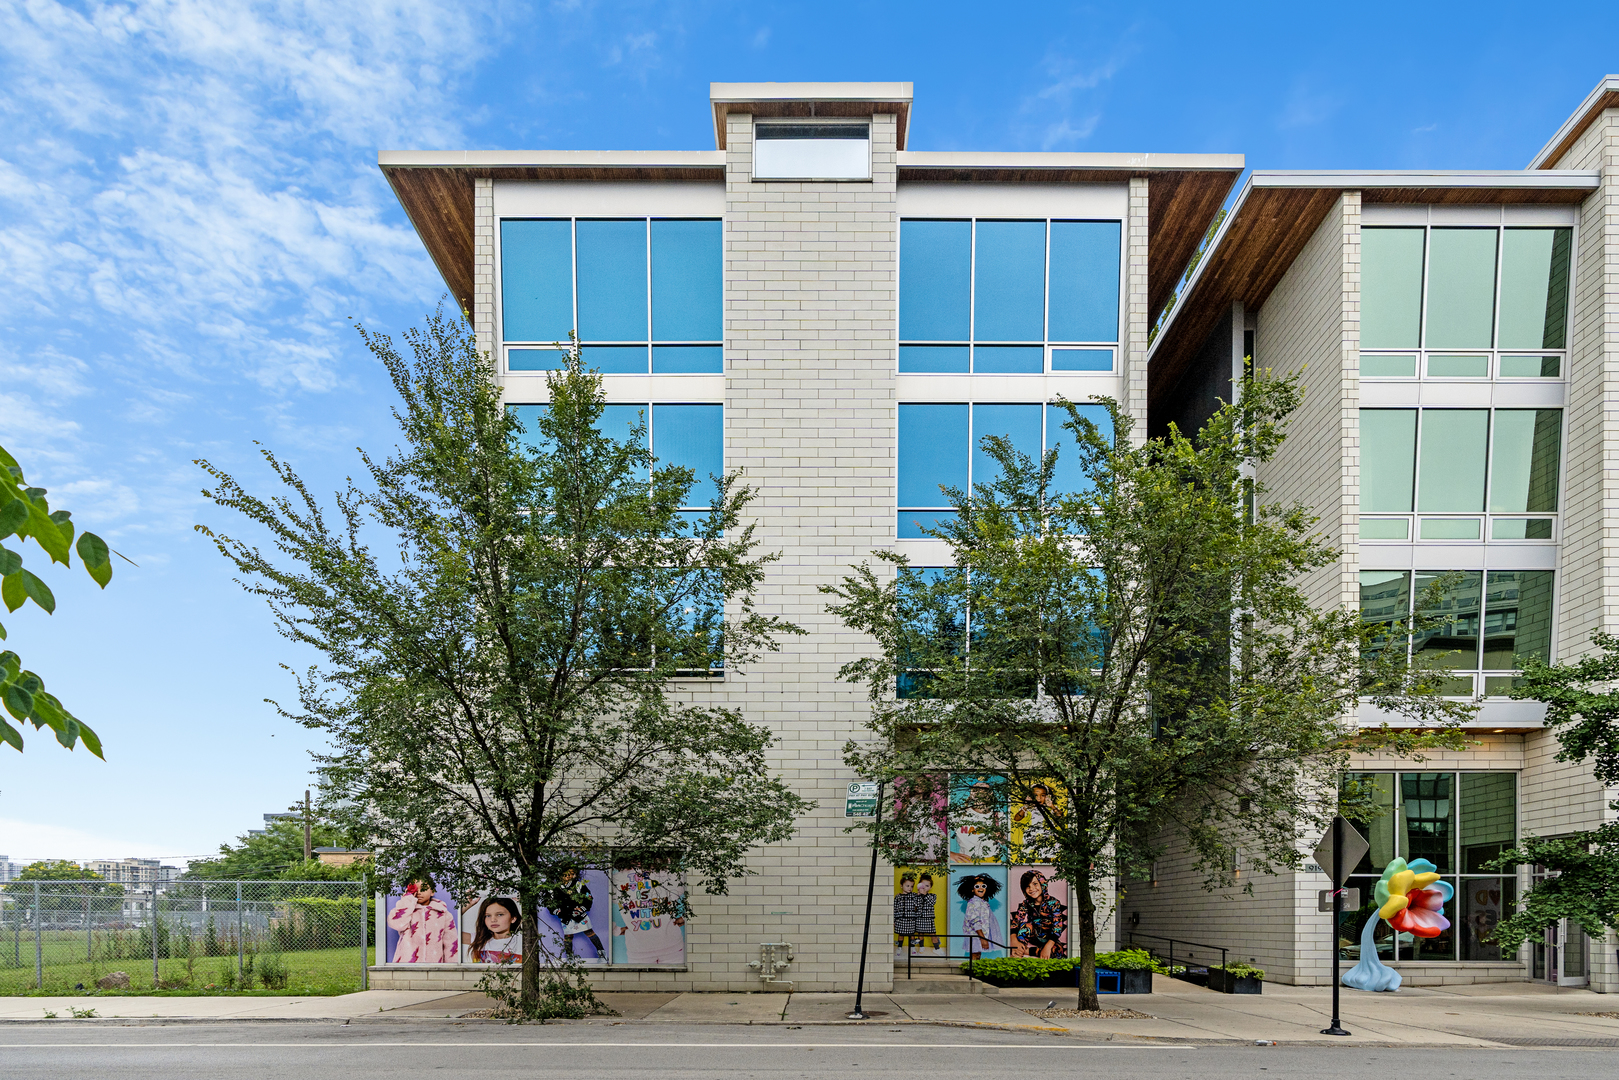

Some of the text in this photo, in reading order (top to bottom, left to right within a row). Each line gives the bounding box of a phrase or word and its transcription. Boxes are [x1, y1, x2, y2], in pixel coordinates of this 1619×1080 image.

[627, 871, 650, 882] THE
[636, 891, 649, 900] IS
[630, 908, 660, 919] WITH
[631, 919, 662, 932] YOU
